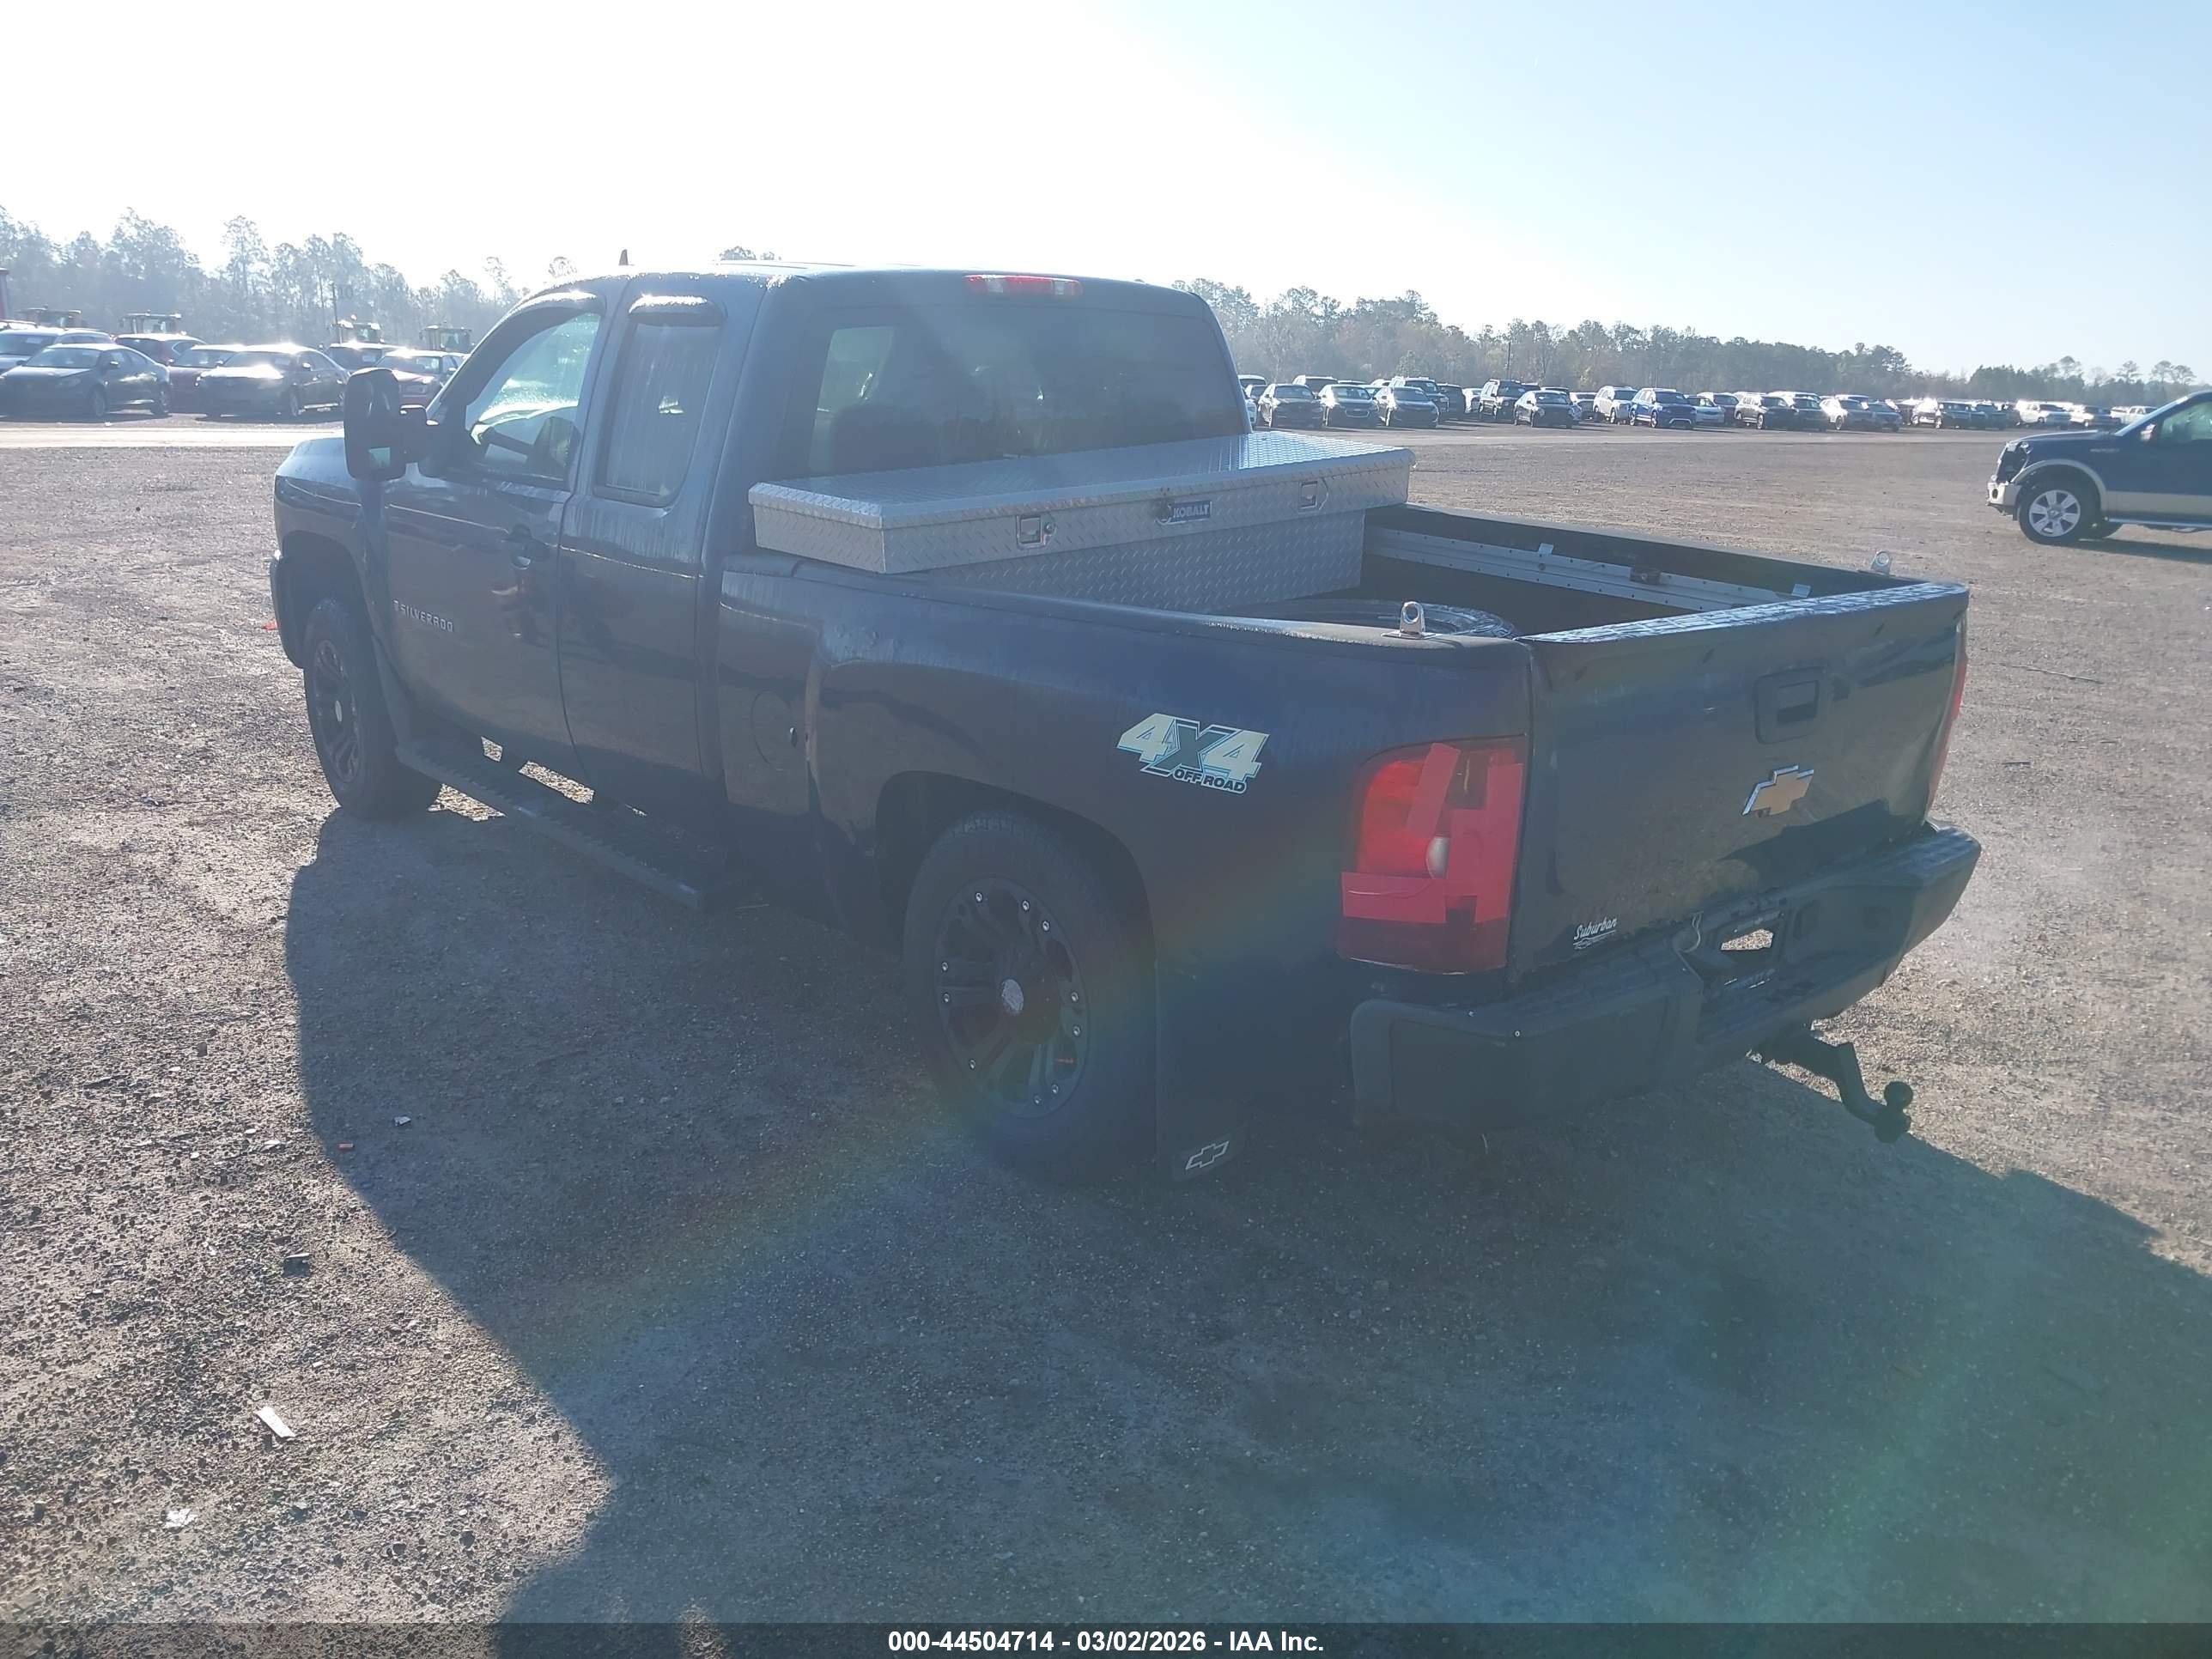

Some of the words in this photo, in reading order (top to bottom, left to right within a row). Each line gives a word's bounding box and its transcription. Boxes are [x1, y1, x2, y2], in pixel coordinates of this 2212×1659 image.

[1173, 504, 1210, 518] KOBALT
[400, 604, 454, 632] SILVERADO
[1117, 714, 1270, 777] 4X4
[1174, 769, 1202, 784] OFF
[1203, 775, 1245, 792] ROAD
[1573, 916, 1617, 940] Suburban
